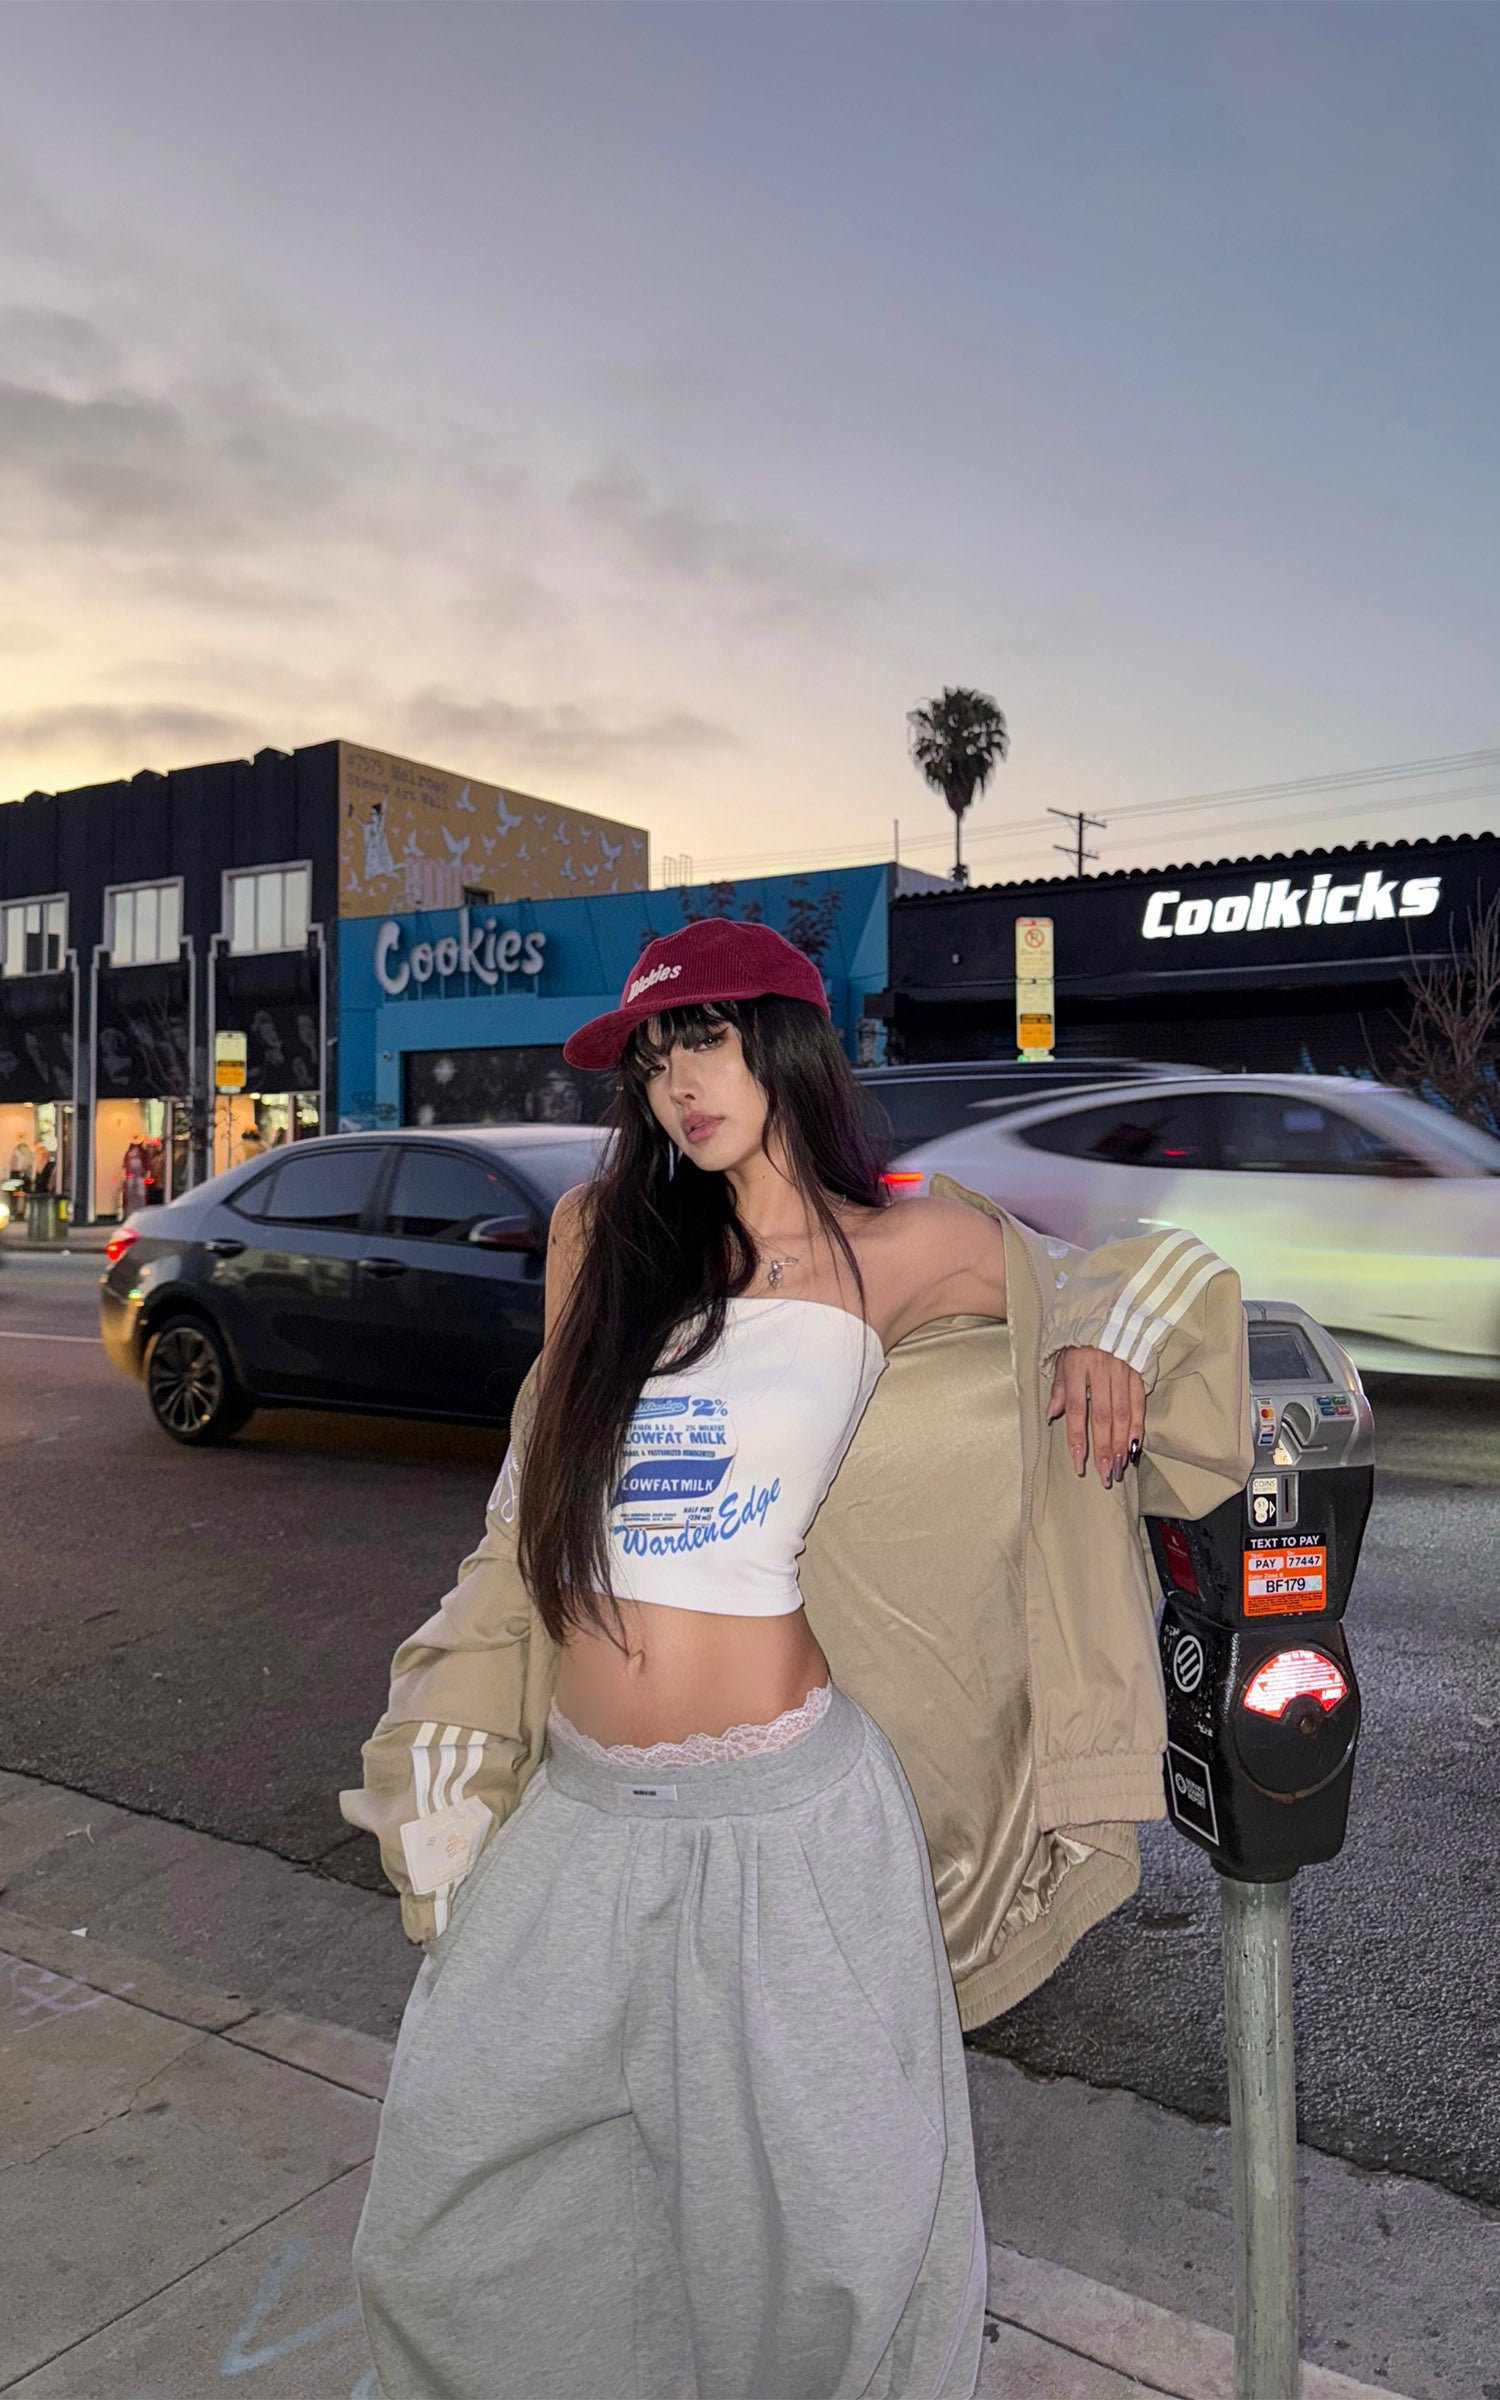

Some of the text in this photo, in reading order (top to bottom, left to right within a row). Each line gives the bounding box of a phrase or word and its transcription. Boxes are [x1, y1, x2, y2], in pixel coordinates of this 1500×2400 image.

[1142, 870, 1441, 939] Coolkicks
[375, 907, 546, 995] Cookies
[692, 1398, 728, 1417] 2%
[624, 1431, 726, 1445] LOWFAT MILK
[622, 1478, 714, 1492] LOWFAT MILK
[612, 1477, 781, 1556] Warden Edge
[1250, 1535, 1320, 1549] TEXT TO PAY
[1255, 1559, 1276, 1569] PAY
[1288, 1555, 1321, 1567] 77447
[1266, 1577, 1306, 1593] BF179
